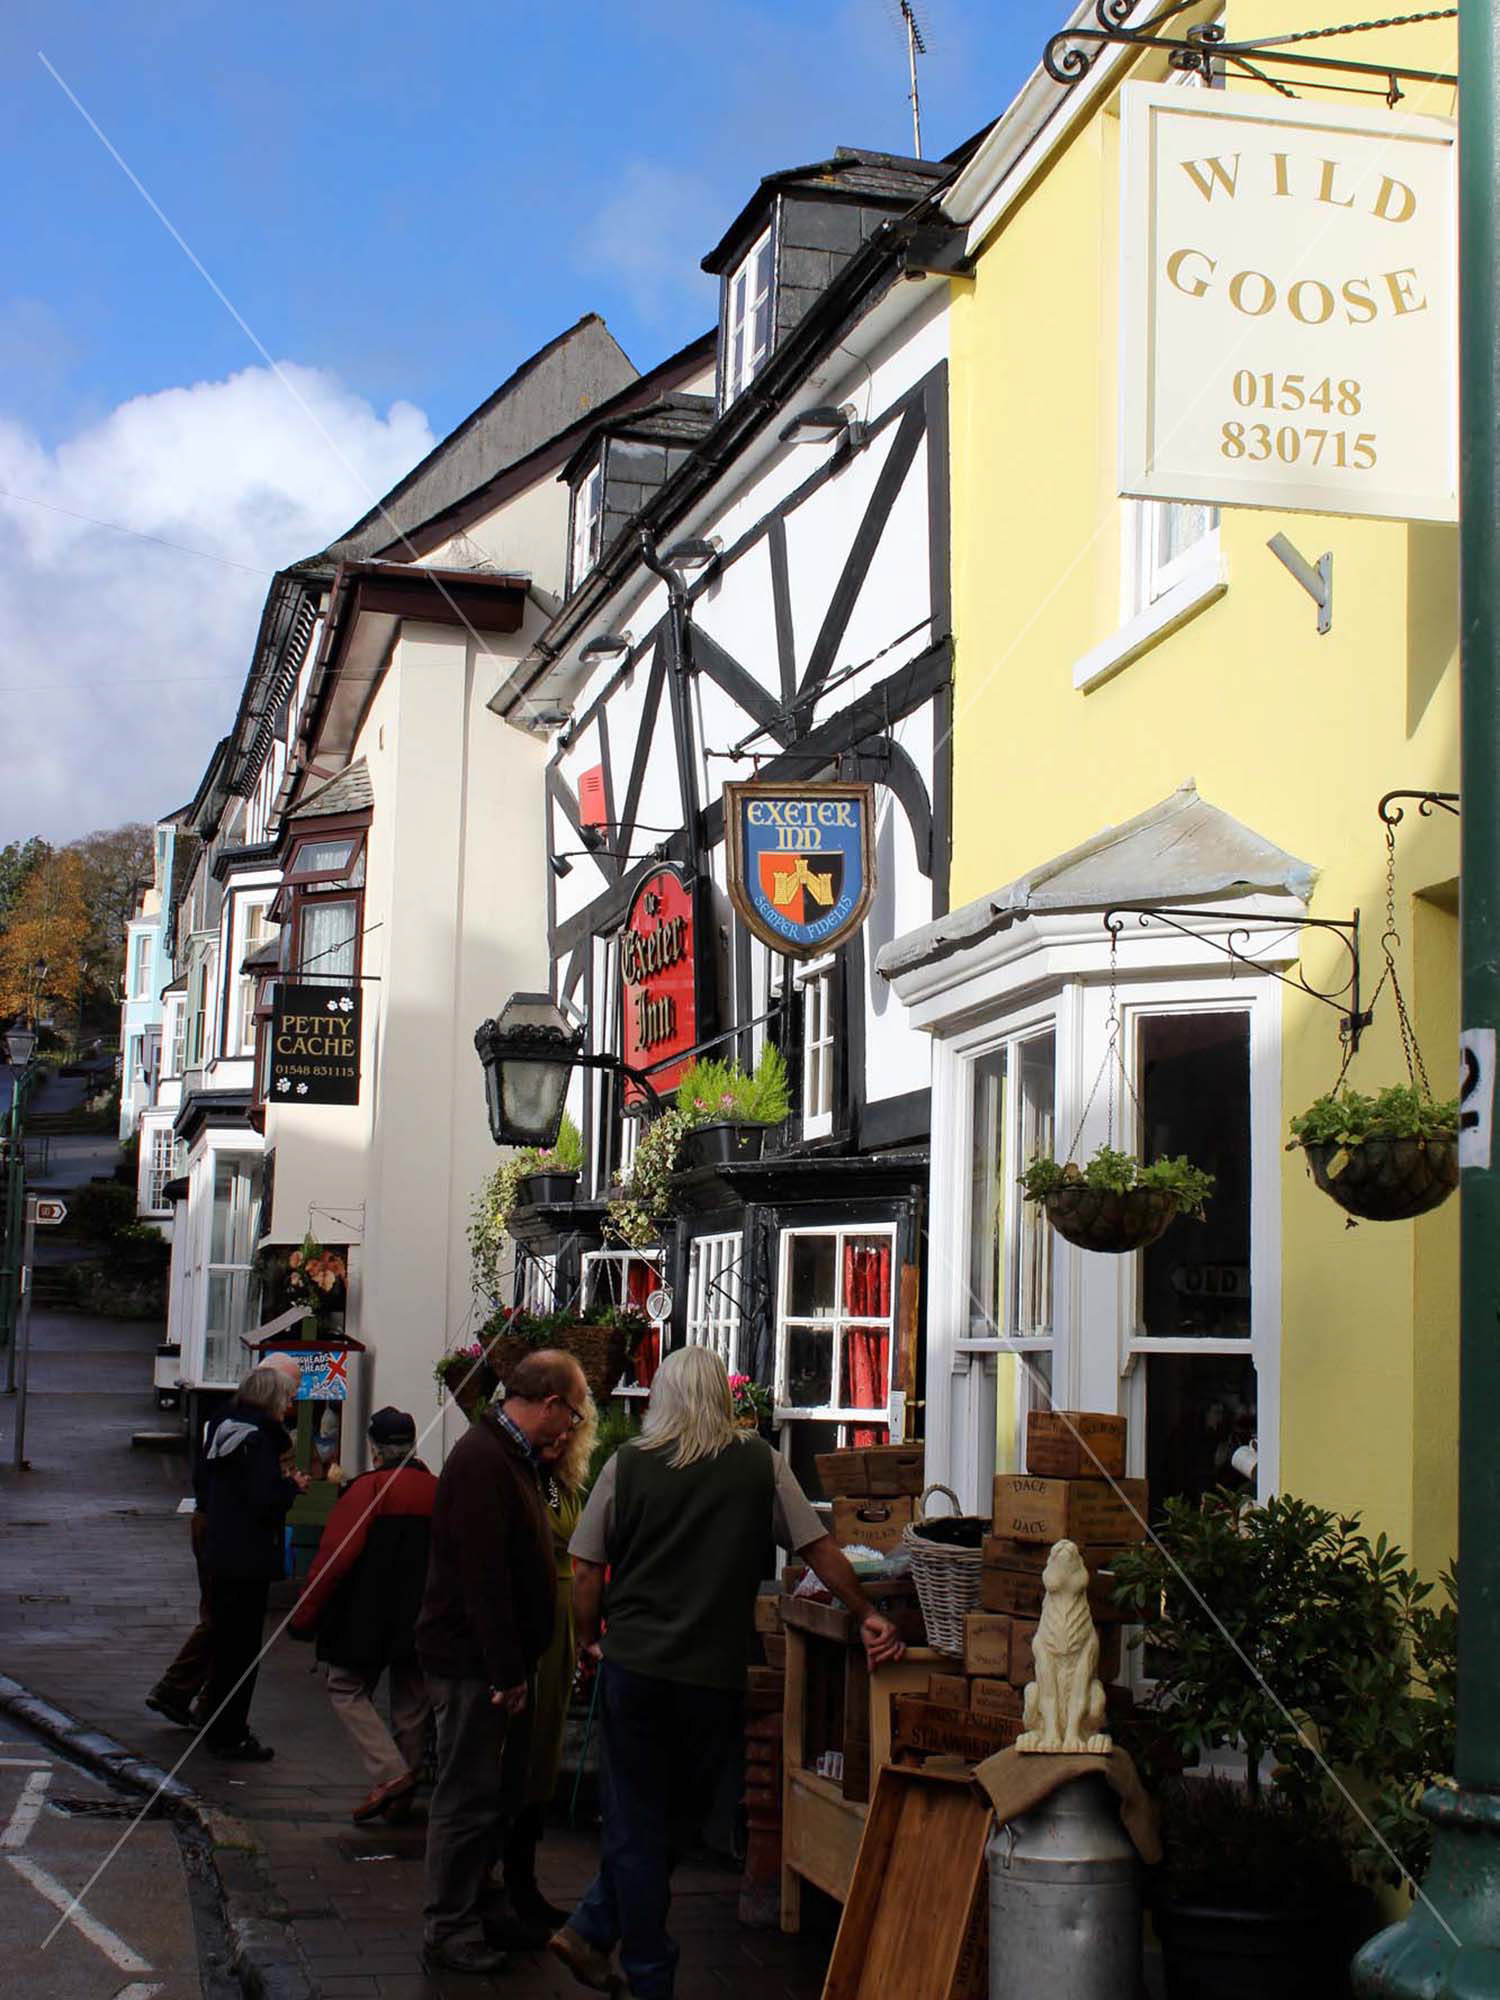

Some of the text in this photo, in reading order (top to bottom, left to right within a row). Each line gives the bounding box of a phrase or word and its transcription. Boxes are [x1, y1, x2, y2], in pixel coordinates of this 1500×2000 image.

[1180, 152, 1417, 224] WILD
[1166, 248, 1428, 326] GOOSE
[1232, 369, 1362, 417] 01548
[1220, 421, 1378, 470] 830715
[747, 801, 857, 828] EXETER
[775, 826, 822, 850] INN
[754, 895, 853, 940] SEMPER FIDELIS
[621, 914, 688, 987] Exeter
[281, 1015, 353, 1036] PETTY
[635, 988, 676, 1052] Inn
[276, 1036, 356, 1057] CACHE
[275, 1064, 311, 1076] 01548
